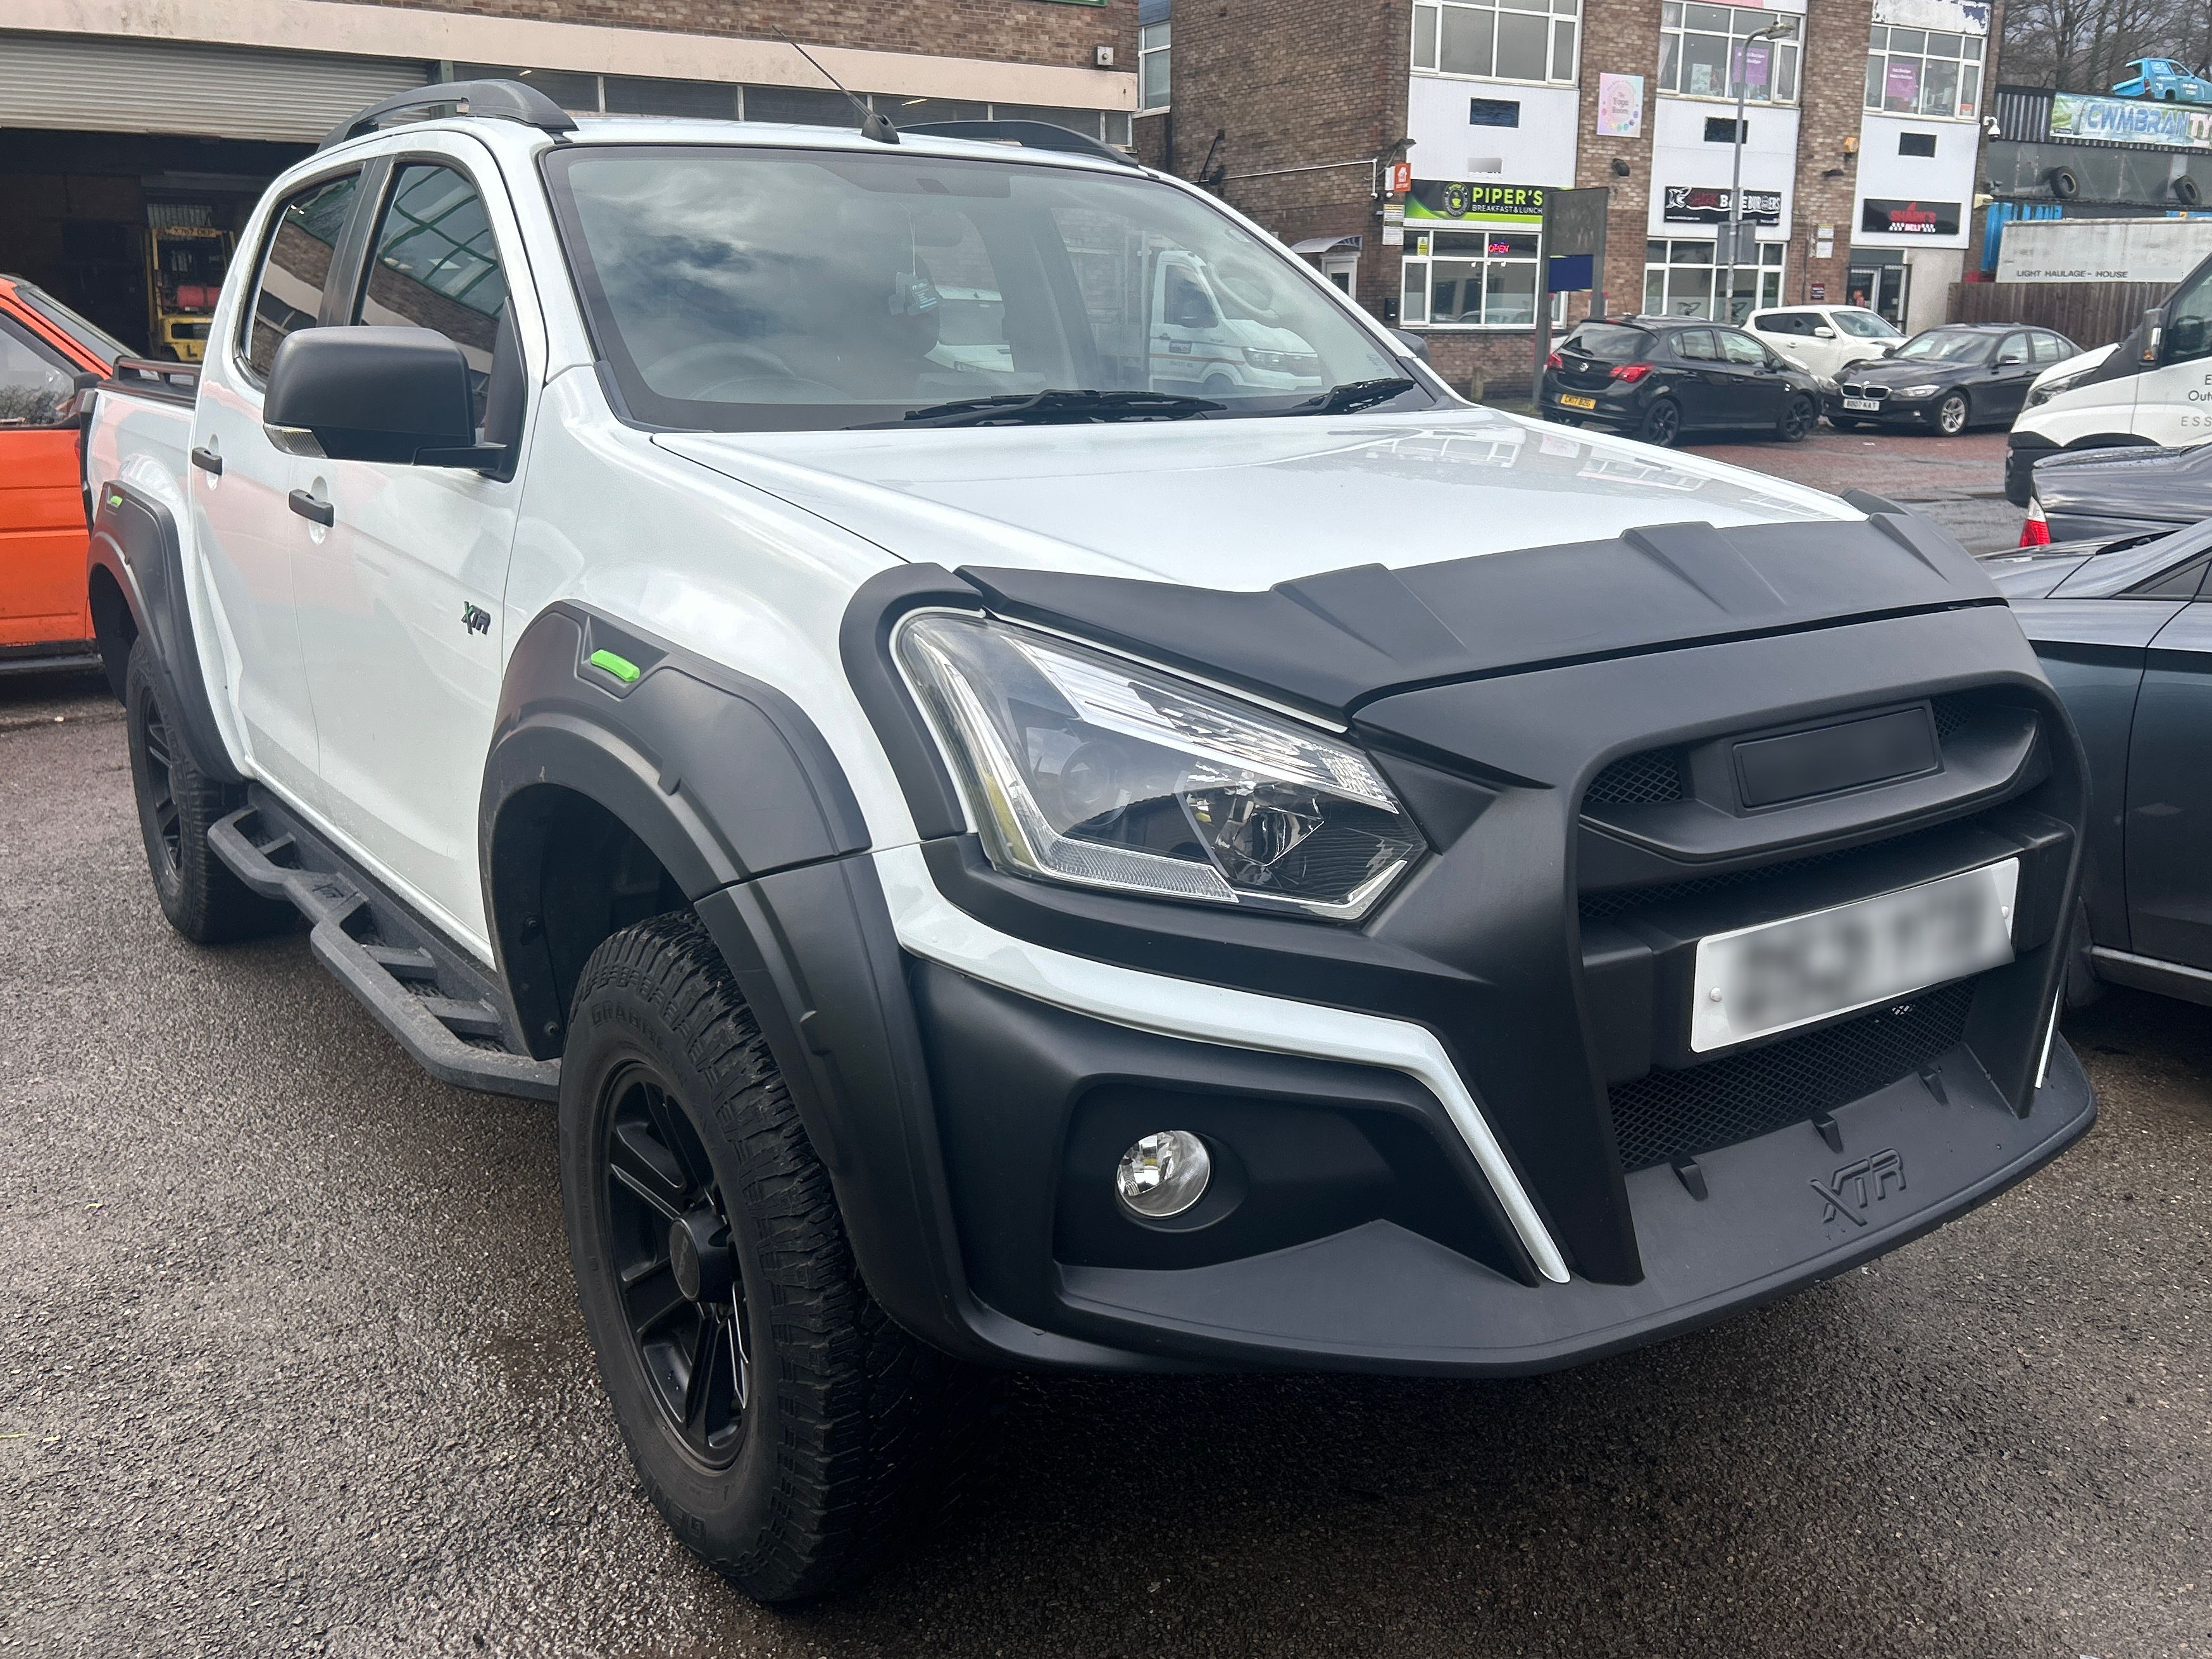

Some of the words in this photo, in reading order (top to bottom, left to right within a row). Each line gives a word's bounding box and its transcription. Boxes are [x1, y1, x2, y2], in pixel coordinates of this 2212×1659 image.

[2088, 103, 2190, 135] CWMBRAN
[1472, 187, 1543, 206] PIPER'S
[1489, 244, 1509, 253] OPEN
[461, 601, 491, 635] XTR
[1810, 1148, 1906, 1227] XTR
